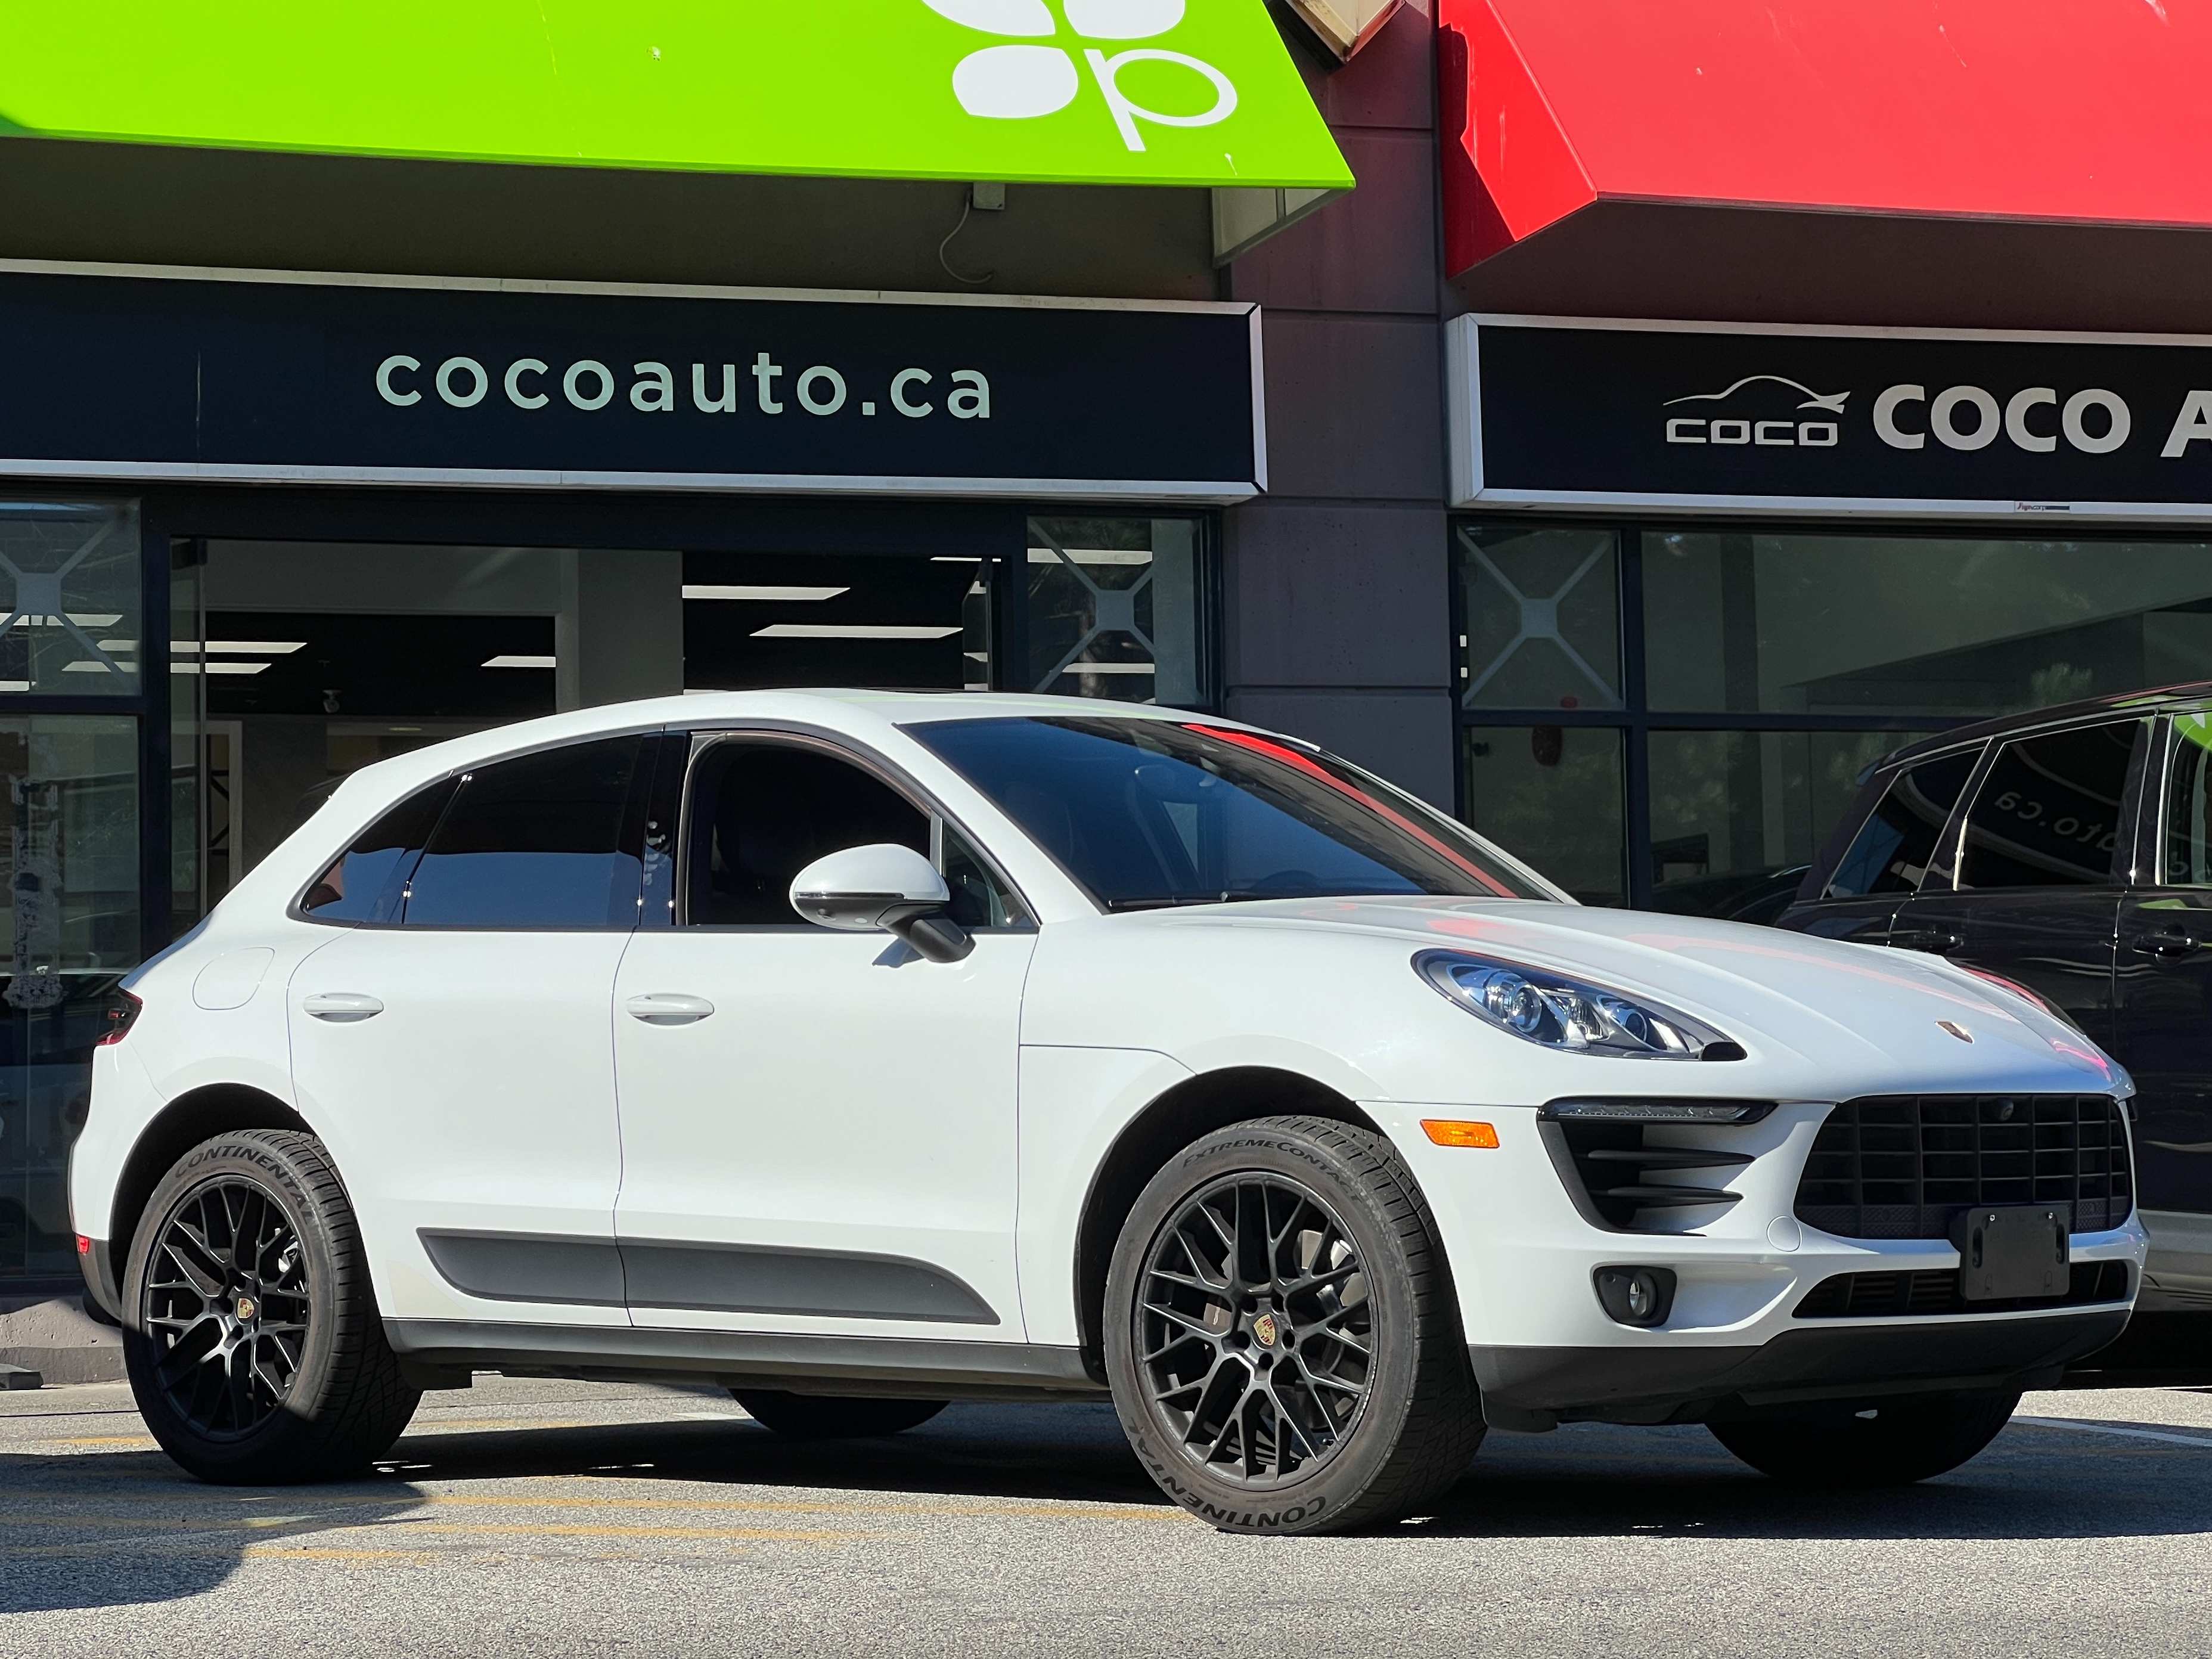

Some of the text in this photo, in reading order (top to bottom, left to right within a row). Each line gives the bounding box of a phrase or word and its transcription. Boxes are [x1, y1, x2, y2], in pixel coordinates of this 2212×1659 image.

[376, 352, 991, 419] cocoauto.ca
[1873, 384, 2131, 454] COCO
[1666, 418, 1839, 446] COCO
[175, 1145, 314, 1225] CONTINENTAL
[1128, 1416, 1326, 1527] CONTINENTAL
